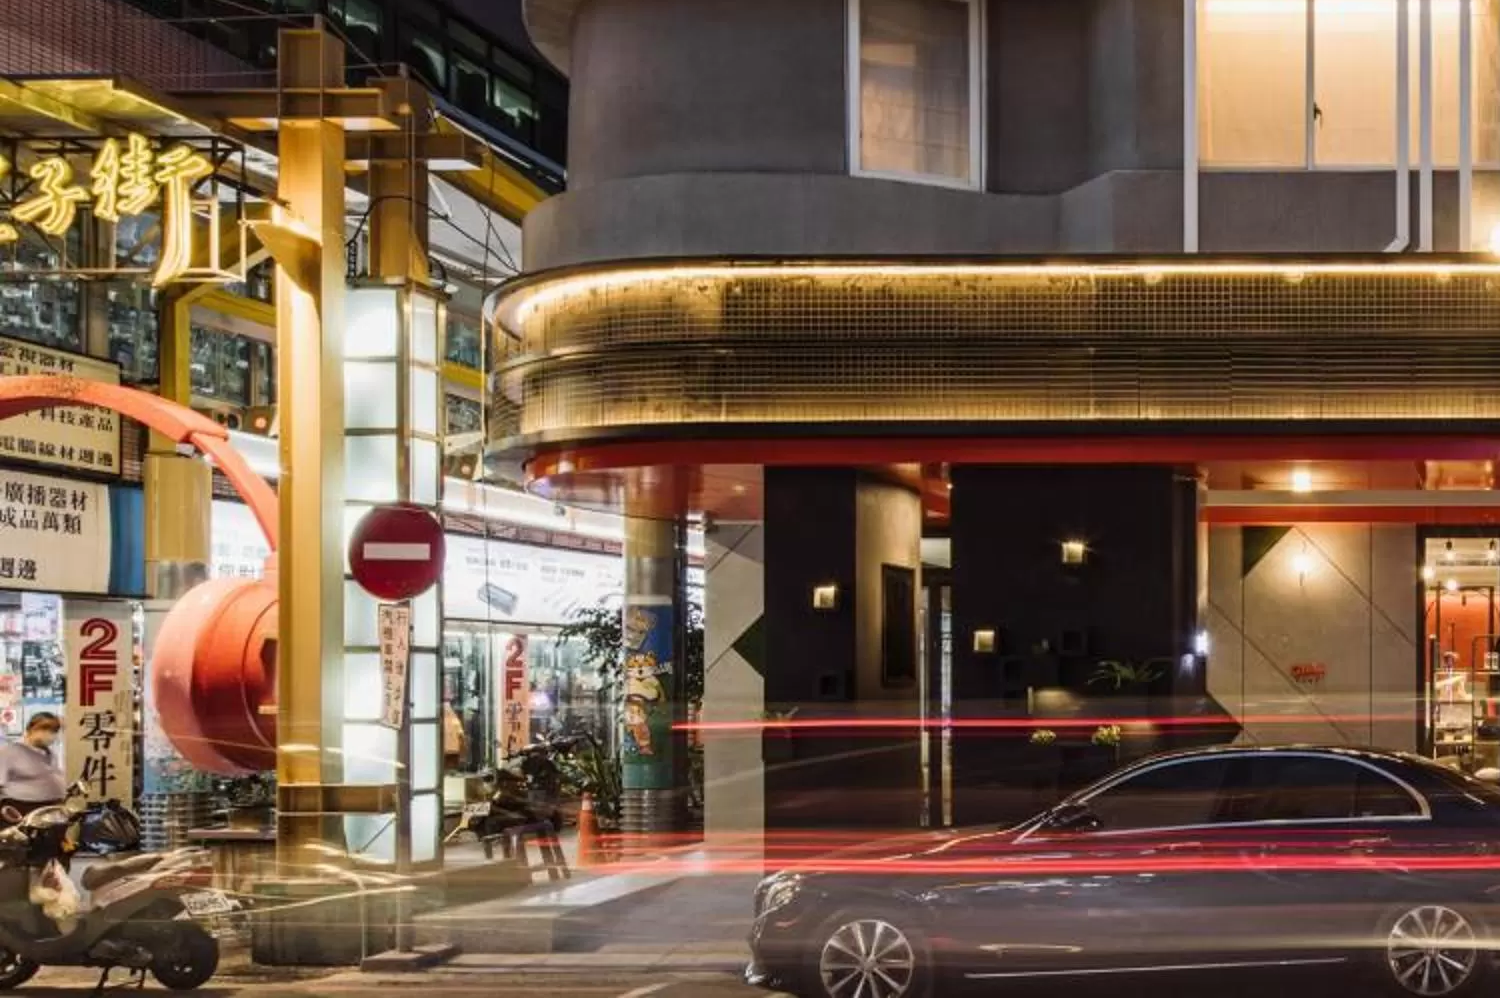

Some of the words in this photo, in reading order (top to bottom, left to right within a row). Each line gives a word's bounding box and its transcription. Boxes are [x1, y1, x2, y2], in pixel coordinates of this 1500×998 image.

[0, 132, 214, 288] 子街
[0, 481, 88, 512] 廣播器材
